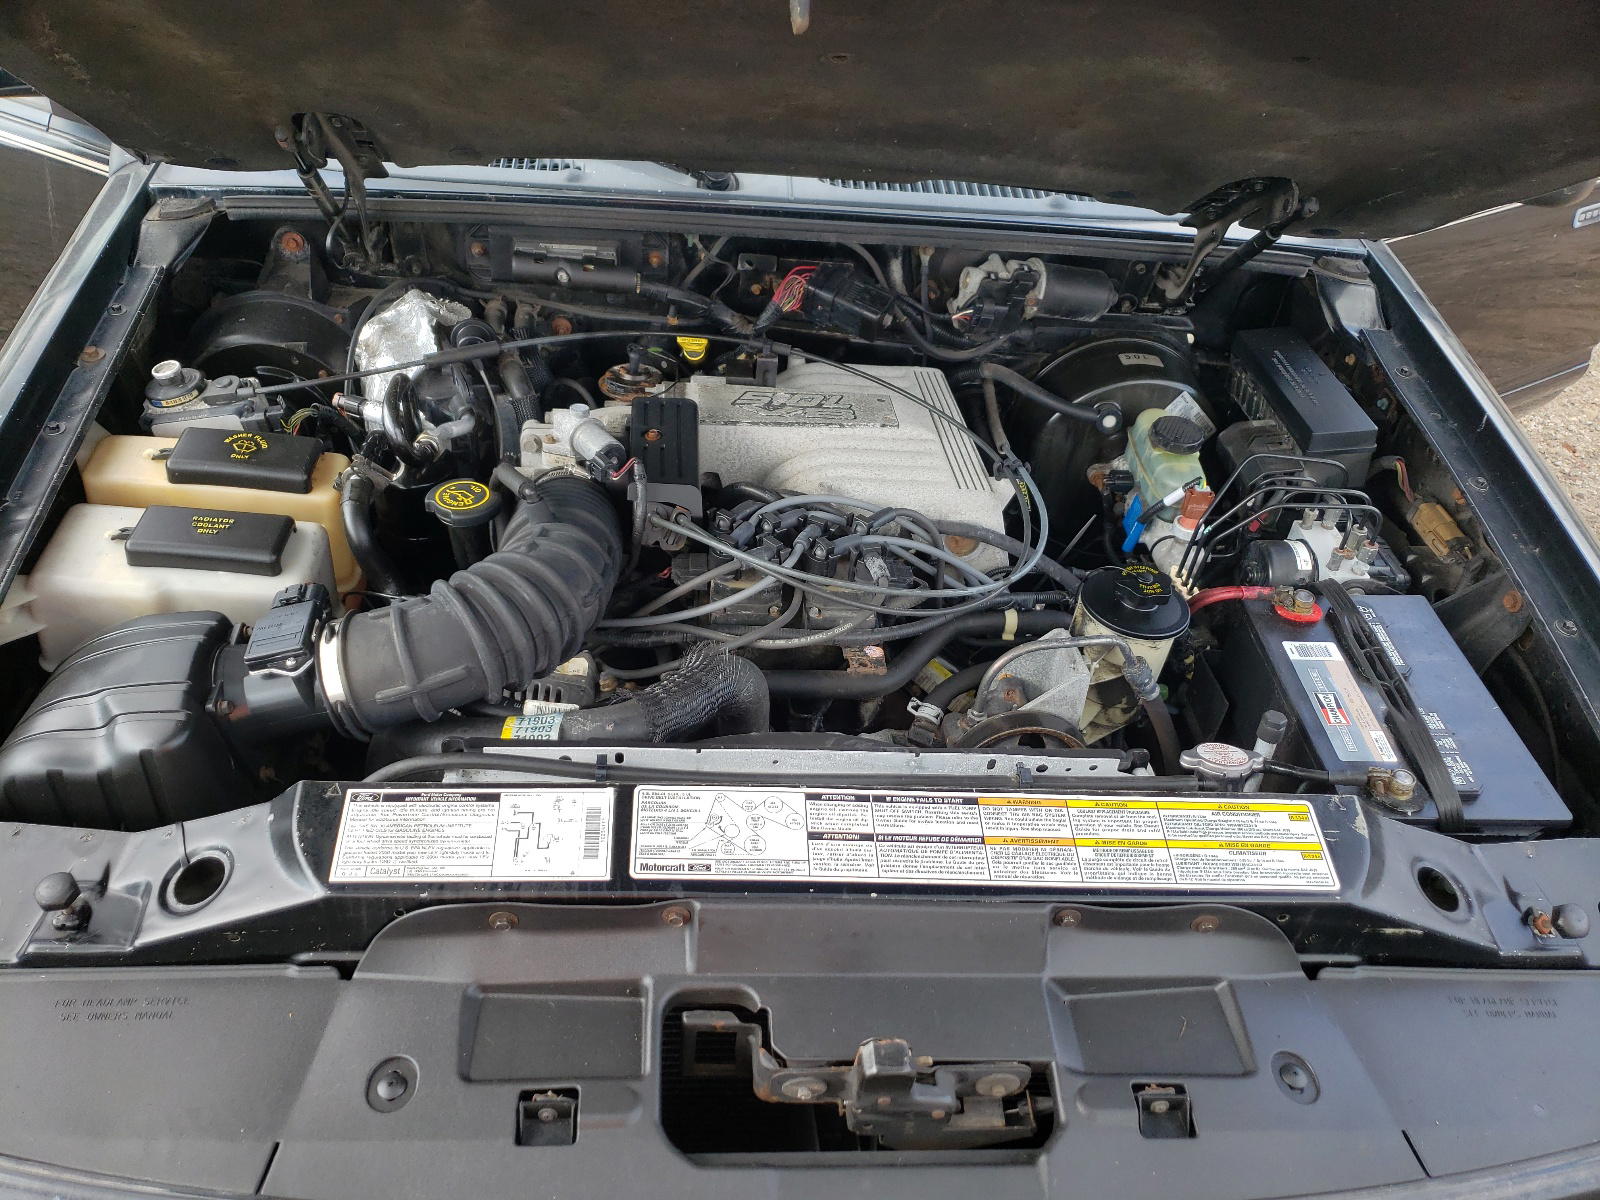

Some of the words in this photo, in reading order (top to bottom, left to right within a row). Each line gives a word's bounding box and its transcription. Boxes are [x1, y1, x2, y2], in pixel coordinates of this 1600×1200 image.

[223, 433, 252, 444] WASHER
[469, 484, 482, 493] OIL
[192, 515, 235, 524] RADIATOR
[191, 521, 230, 530] COOLANT
[517, 715, 556, 726] 71903
[515, 724, 553, 734] 71903
[370, 867, 401, 876] Catalyst
[639, 863, 685, 872] Motorcraft
[54, 998, 77, 1008] FOR
[82, 998, 137, 1008] HEADLAMP
[134, 1011, 173, 1021] MANUAL
